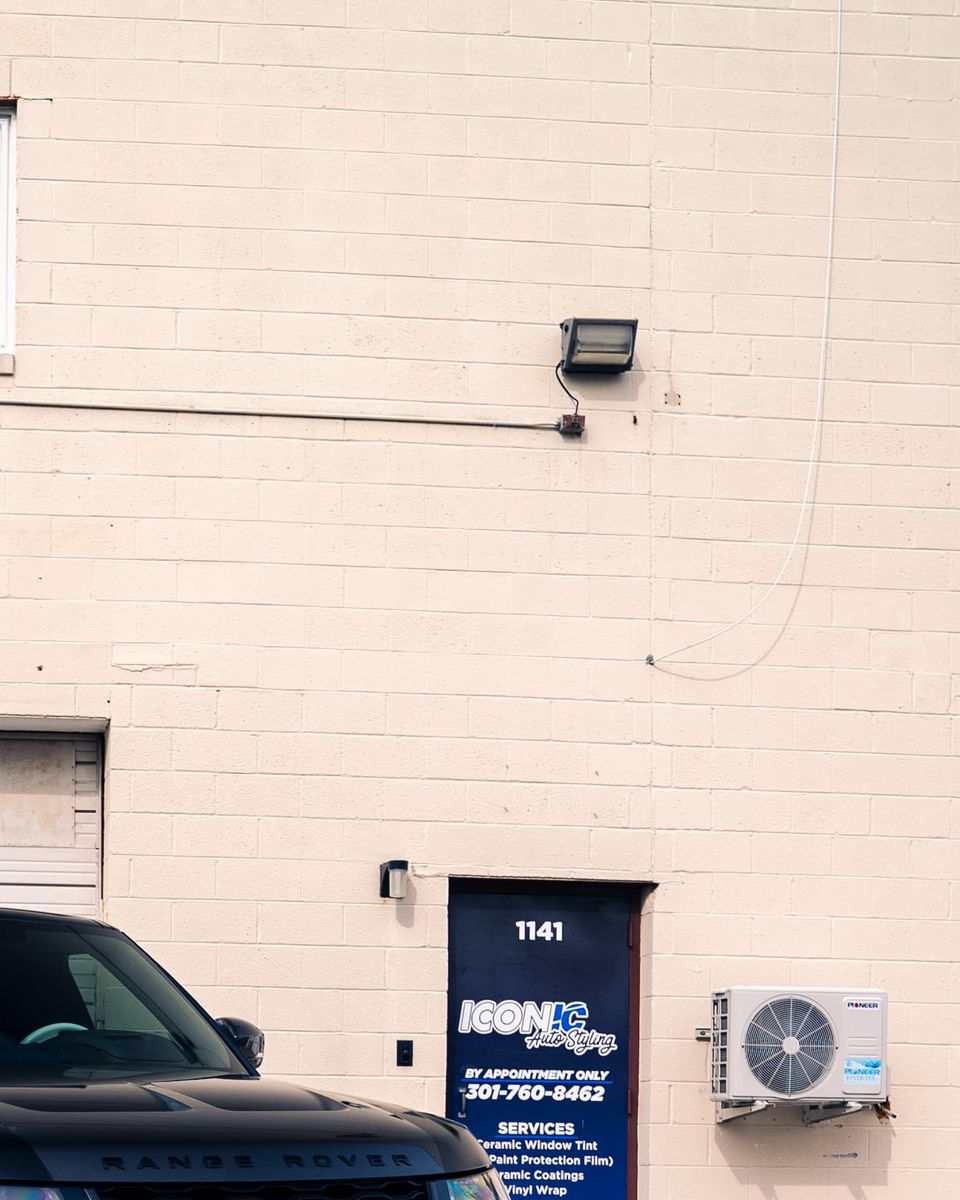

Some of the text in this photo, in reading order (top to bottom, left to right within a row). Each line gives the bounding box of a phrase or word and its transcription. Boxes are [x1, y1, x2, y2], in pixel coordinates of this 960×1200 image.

[515, 920, 563, 941] 1141
[458, 1000, 589, 1035] ICONIC
[526, 1029, 617, 1055] Auto Styling
[465, 1068, 610, 1081] BY APPOINTMENT ONLY
[465, 1083, 606, 1102] 301-760-8462
[498, 1122, 575, 1135] SERVICES
[525, 1139, 572, 1150] Window
[575, 1140, 598, 1151] Tint
[101, 1154, 412, 1170] RANGE ROVER
[521, 1154, 580, 1165] Protection
[584, 1155, 614, 1167] Film)
[499, 1170, 585, 1182] ramic Coatings
[536, 1185, 568, 1197] Wrap
